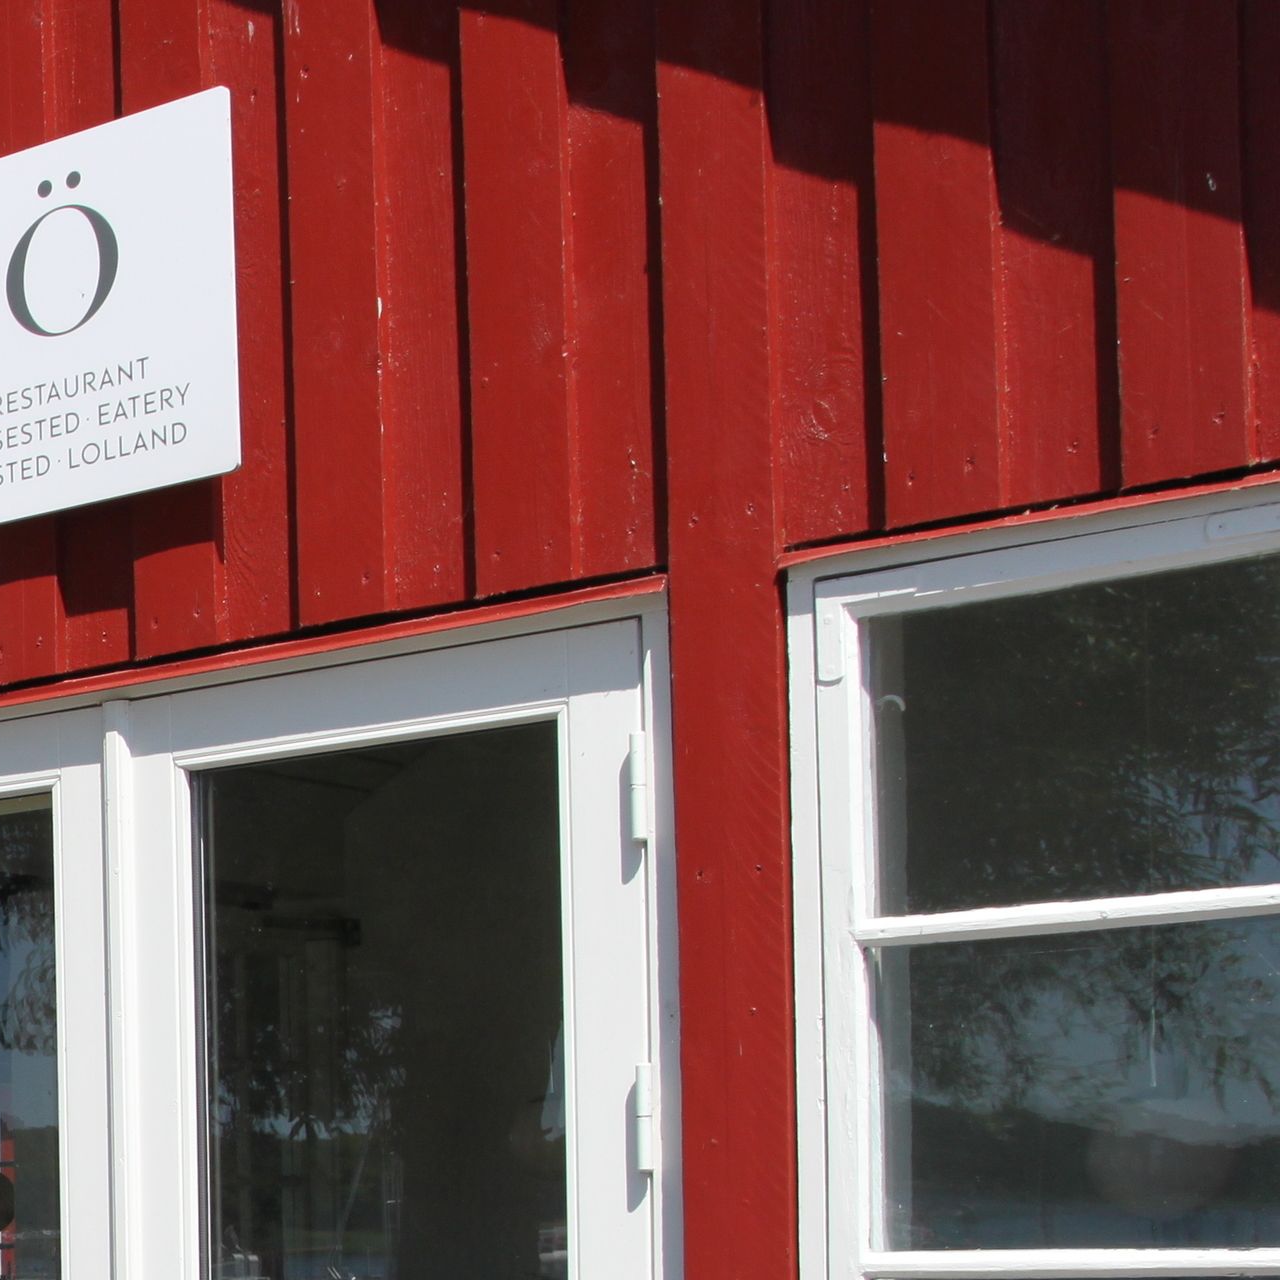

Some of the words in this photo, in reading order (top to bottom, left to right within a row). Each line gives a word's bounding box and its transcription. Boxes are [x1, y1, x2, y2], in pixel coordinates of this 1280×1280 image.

[5, 170, 119, 338] Ö
[98, 382, 191, 426] EATERY
[68, 422, 187, 470] LOLLAND
